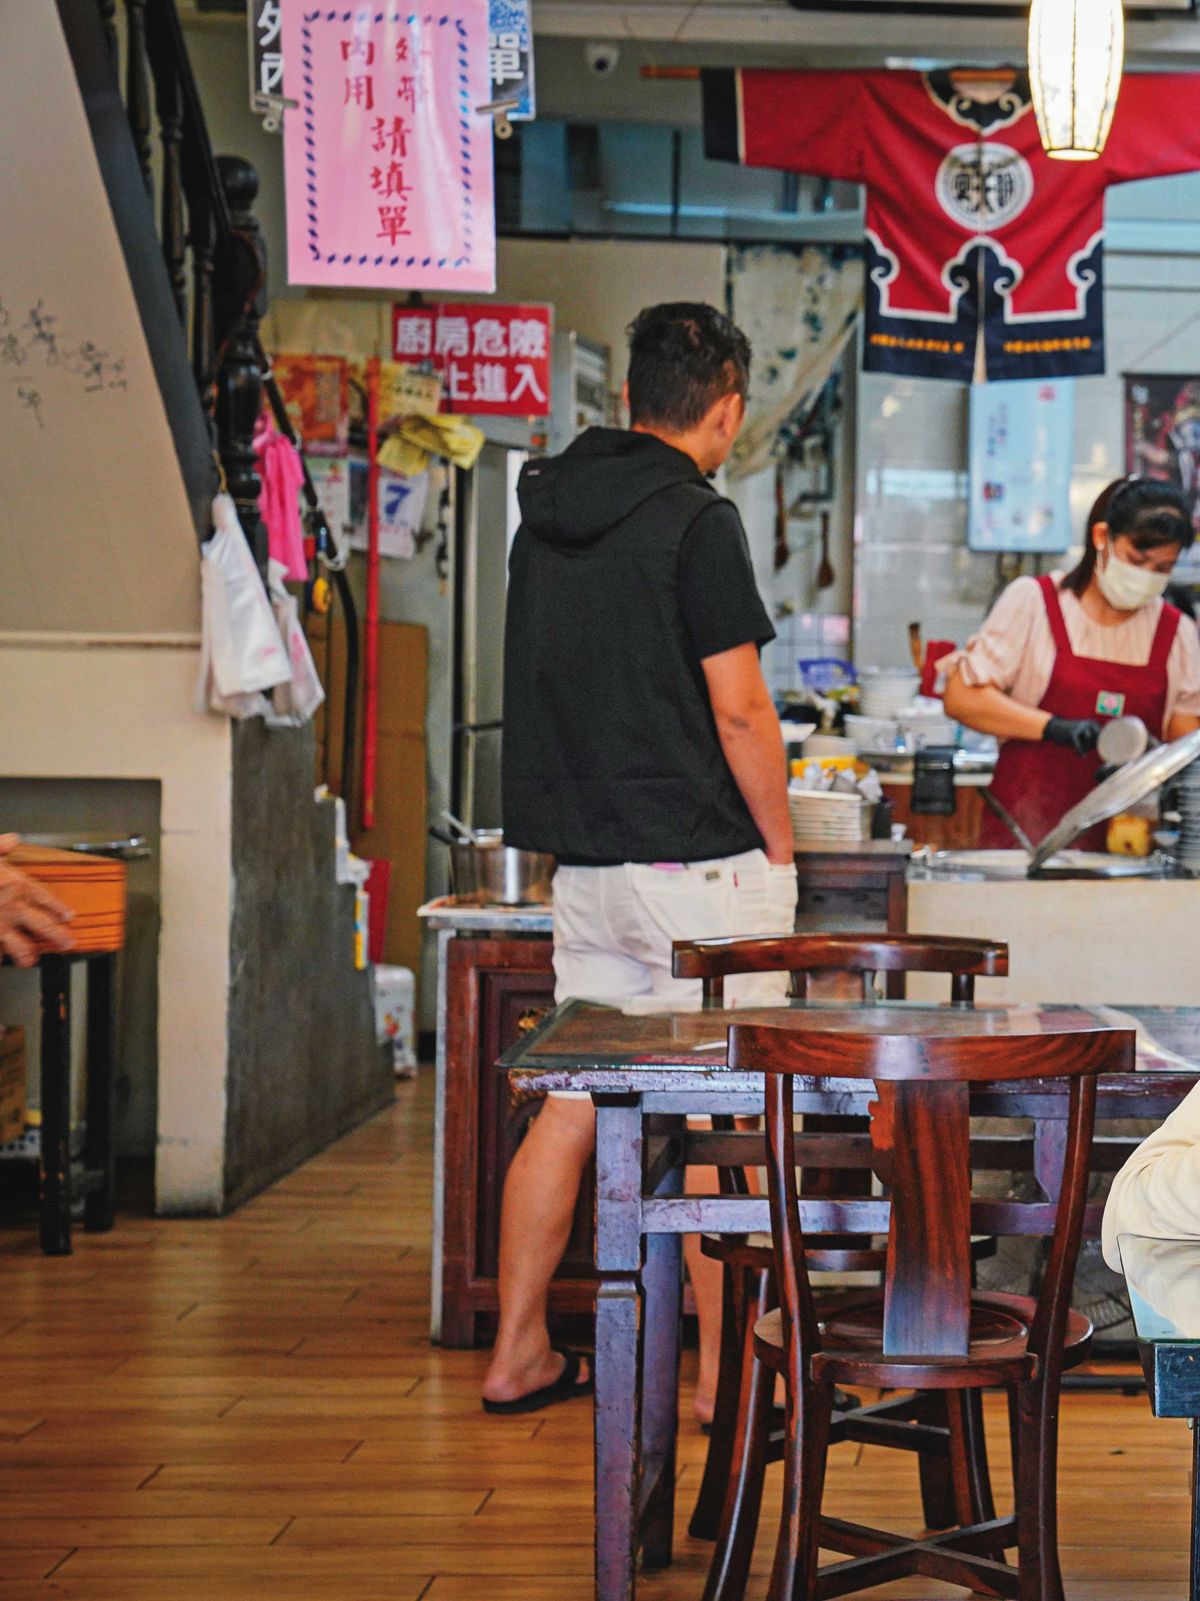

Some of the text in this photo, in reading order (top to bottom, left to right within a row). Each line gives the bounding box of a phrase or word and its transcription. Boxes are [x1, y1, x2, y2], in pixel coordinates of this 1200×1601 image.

[370, 116, 414, 248] 請填單
[396, 315, 547, 359] 廚房危險
[440, 360, 547, 403] 止進入
